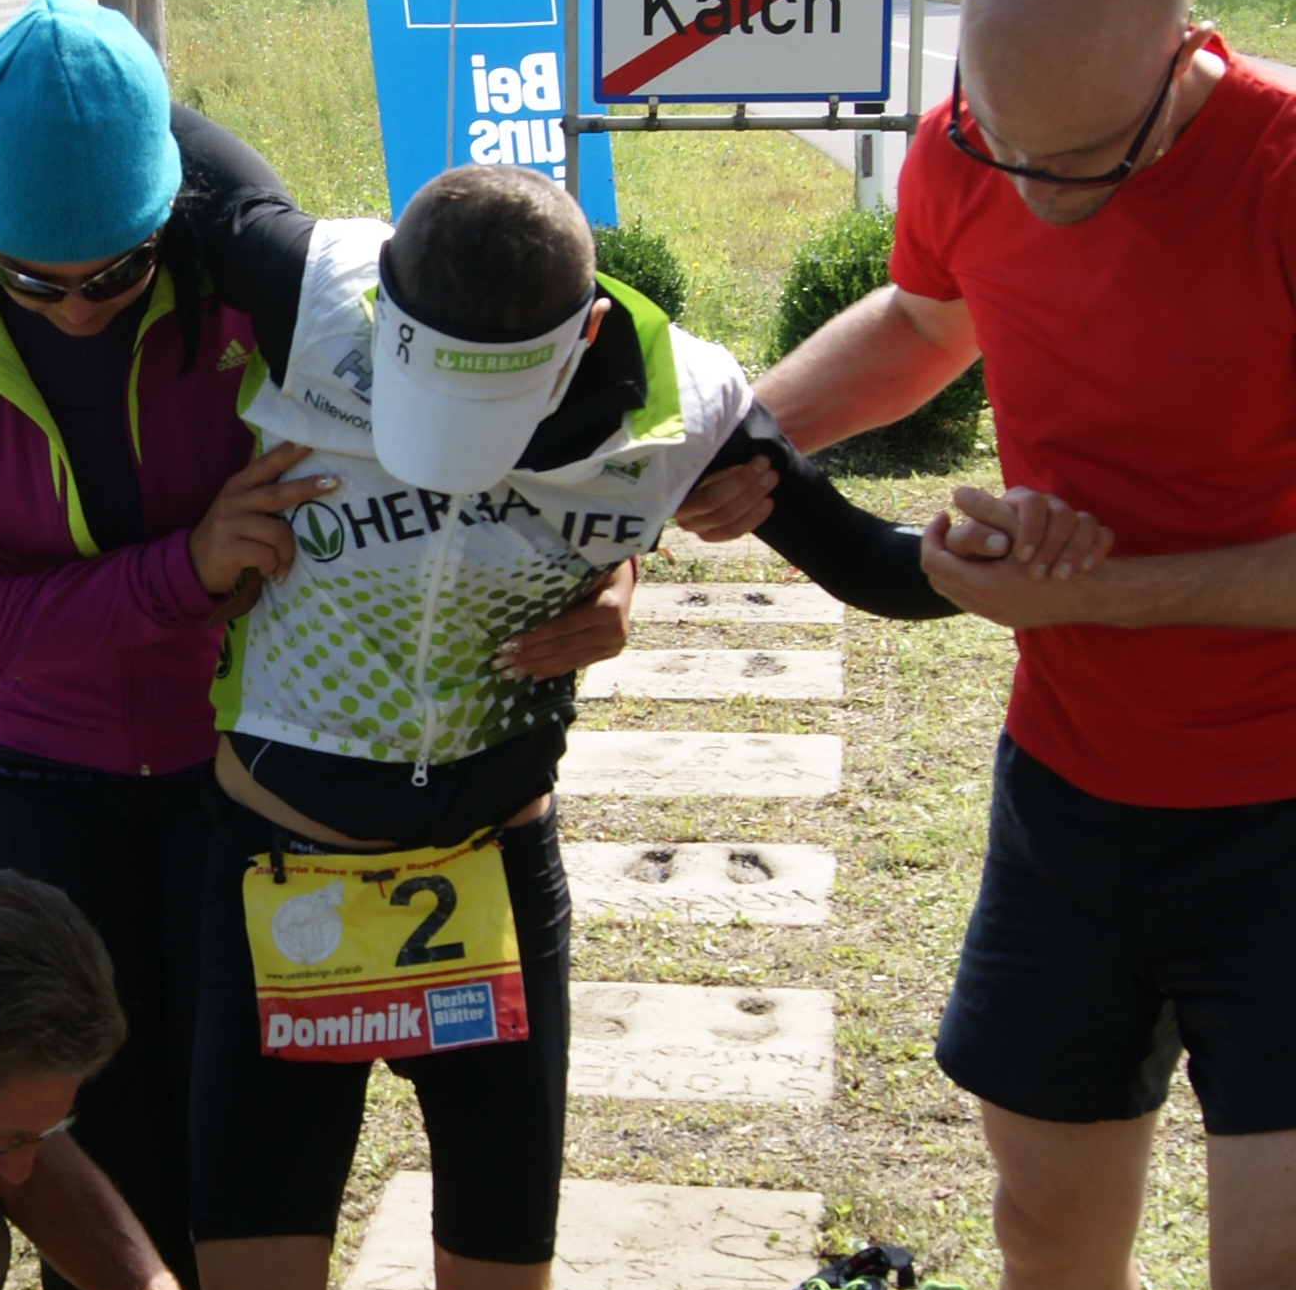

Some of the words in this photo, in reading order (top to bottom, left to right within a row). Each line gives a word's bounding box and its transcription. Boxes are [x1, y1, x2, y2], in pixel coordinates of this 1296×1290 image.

[459, 345, 555, 372] HERBALIFE
[340, 487, 647, 551] HERBAIFE
[389, 874, 466, 968] 2
[431, 989, 487, 1009] Bezirks
[433, 1007, 485, 1027] Blätter
[266, 1002, 424, 1048] Dominik
